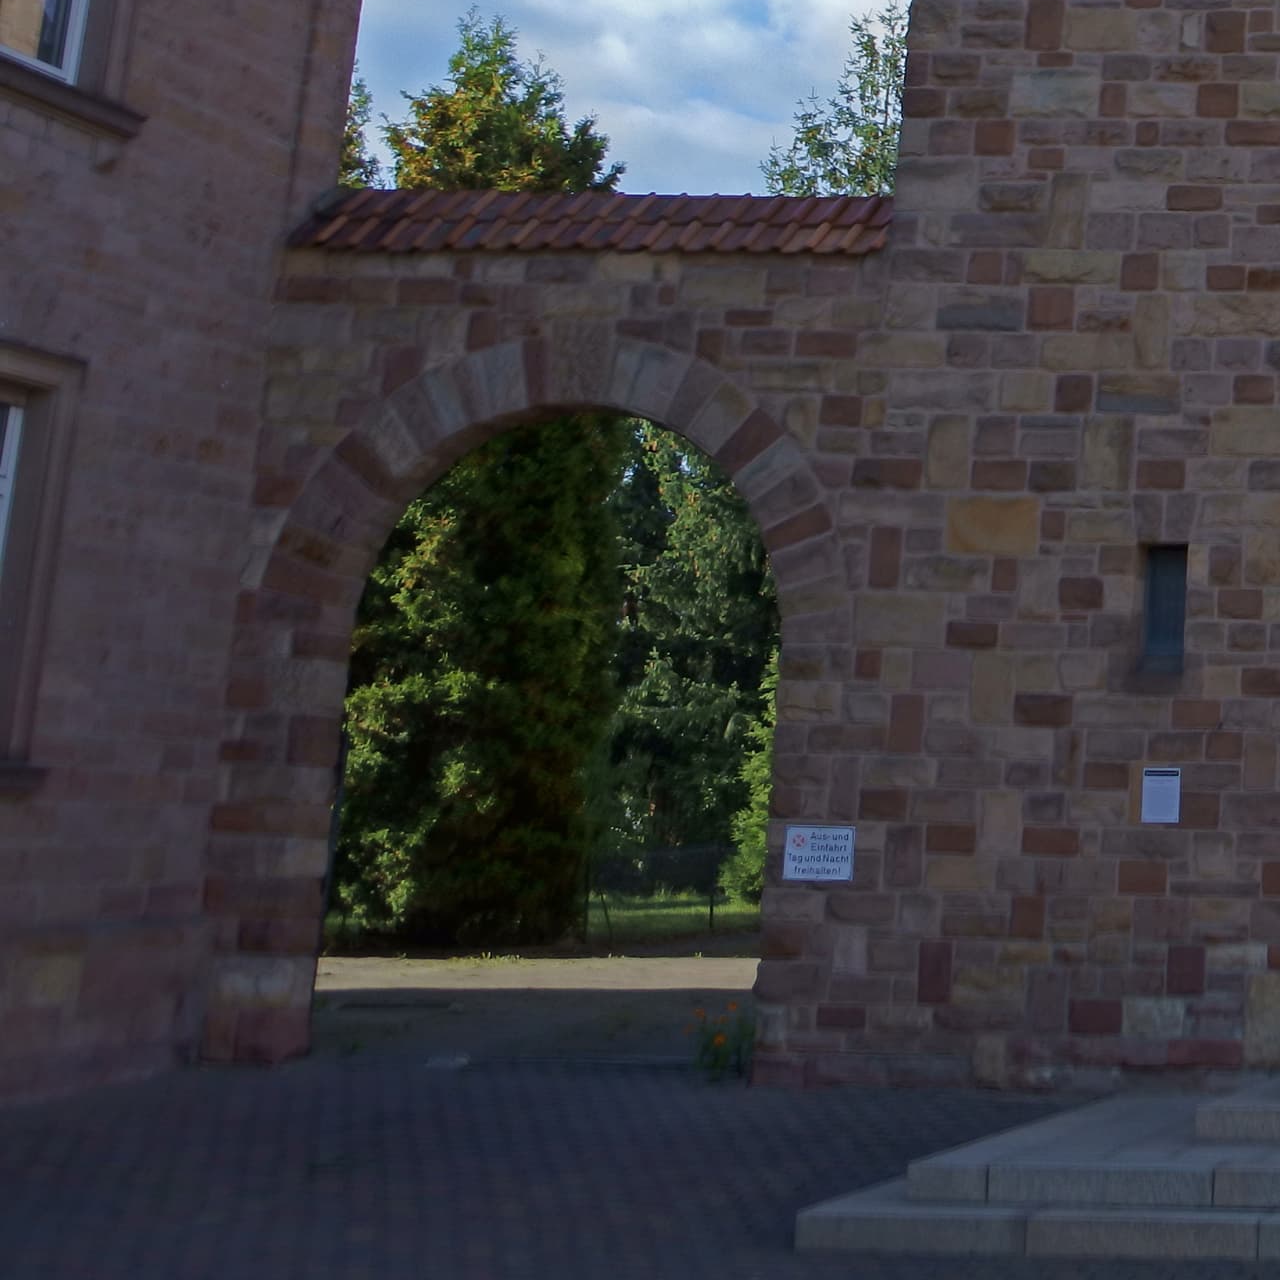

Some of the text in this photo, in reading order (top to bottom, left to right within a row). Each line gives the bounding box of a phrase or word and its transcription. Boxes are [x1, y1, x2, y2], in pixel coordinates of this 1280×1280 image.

[810, 832, 830, 840] Aus-
[811, 843, 847, 851] Einfahrt
[788, 853, 849, 863] Tag und Nacht
[794, 866, 841, 874] freihalten!
